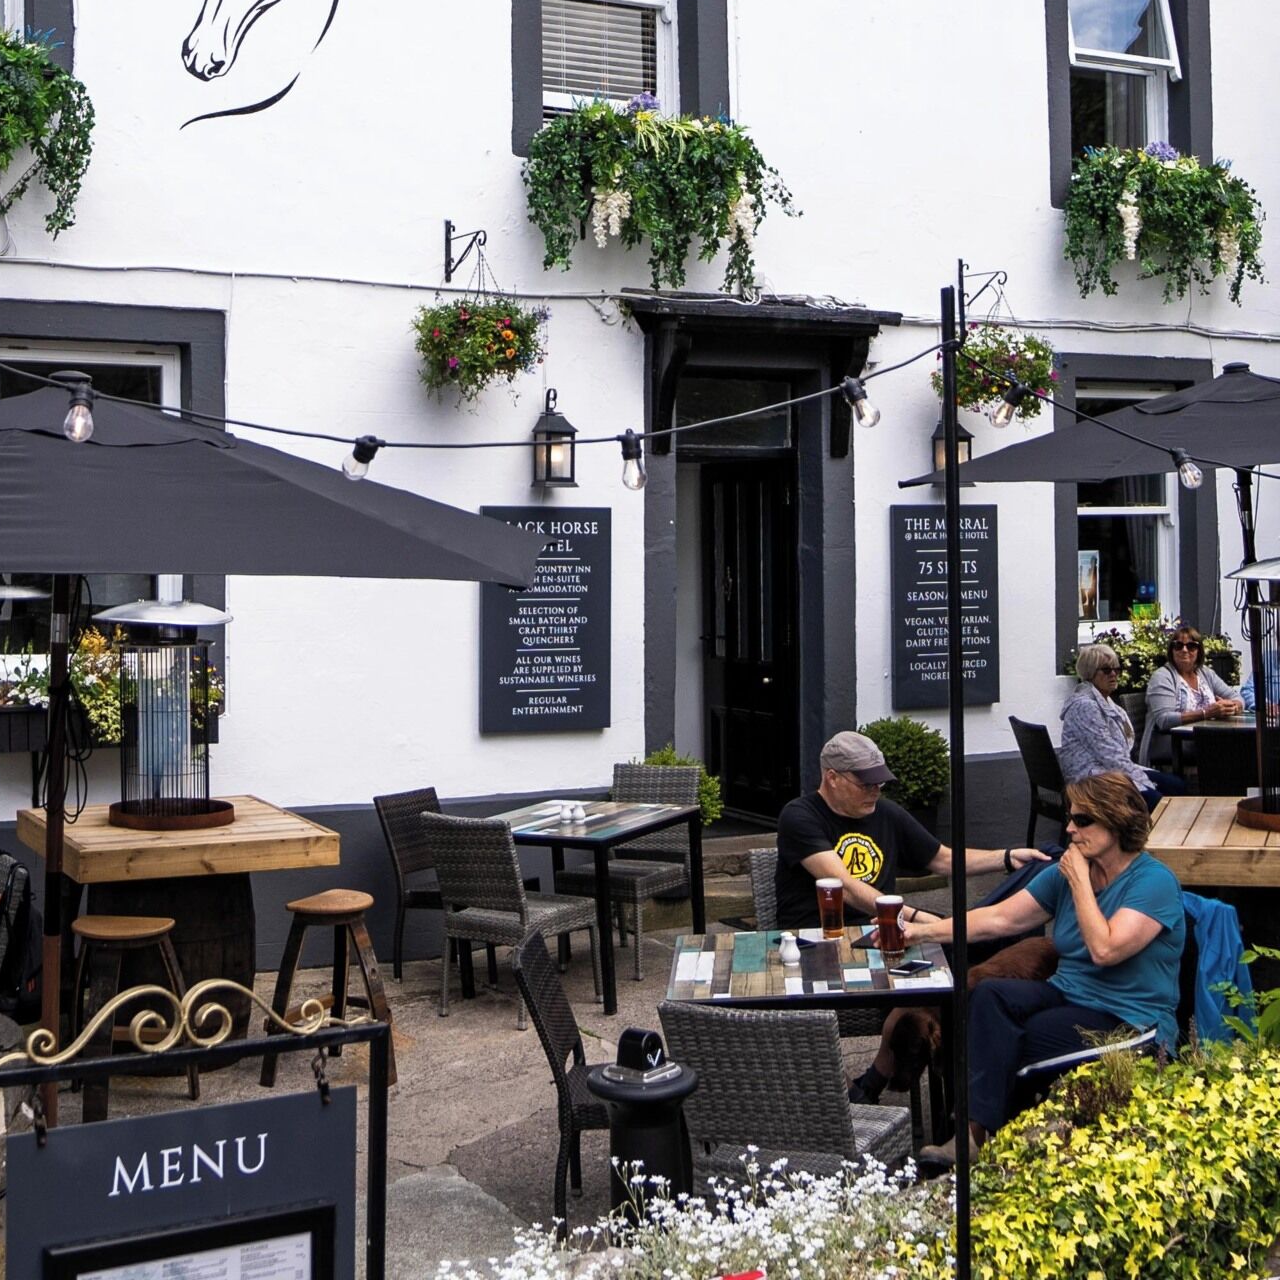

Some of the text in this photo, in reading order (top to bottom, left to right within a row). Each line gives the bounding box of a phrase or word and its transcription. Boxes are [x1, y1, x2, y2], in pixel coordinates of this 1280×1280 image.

[551, 521, 599, 534] HORSE
[904, 518, 931, 530] THE
[905, 532, 912, 540] @
[914, 532, 937, 540] BLACK
[535, 565, 591, 574] OUNTRY INN
[918, 560, 977, 574] 75 STS
[542, 575, 580, 583] EN-SUITE
[907, 590, 988, 602] SEASON MENU
[518, 606, 579, 615] SELECTION OF
[508, 616, 588, 625] SMALL BATCH AND
[518, 626, 578, 635] CRAFT THIRST
[973, 626, 979, 634] &
[522, 636, 574, 646] QUENCHERS
[906, 636, 990, 648] DAIRY FRE PTIONS
[516, 655, 581, 665] ALL OUR WINES
[532, 666, 571, 674] SUPPLIED
[573, 665, 583, 673] BY
[910, 661, 947, 671] LOCALLY
[499, 674, 596, 685] SUSTAINABLE WINERIES
[528, 696, 567, 704] REGULAR
[512, 705, 583, 715] ENTERTAINMENT
[108, 1132, 269, 1199] MENU
